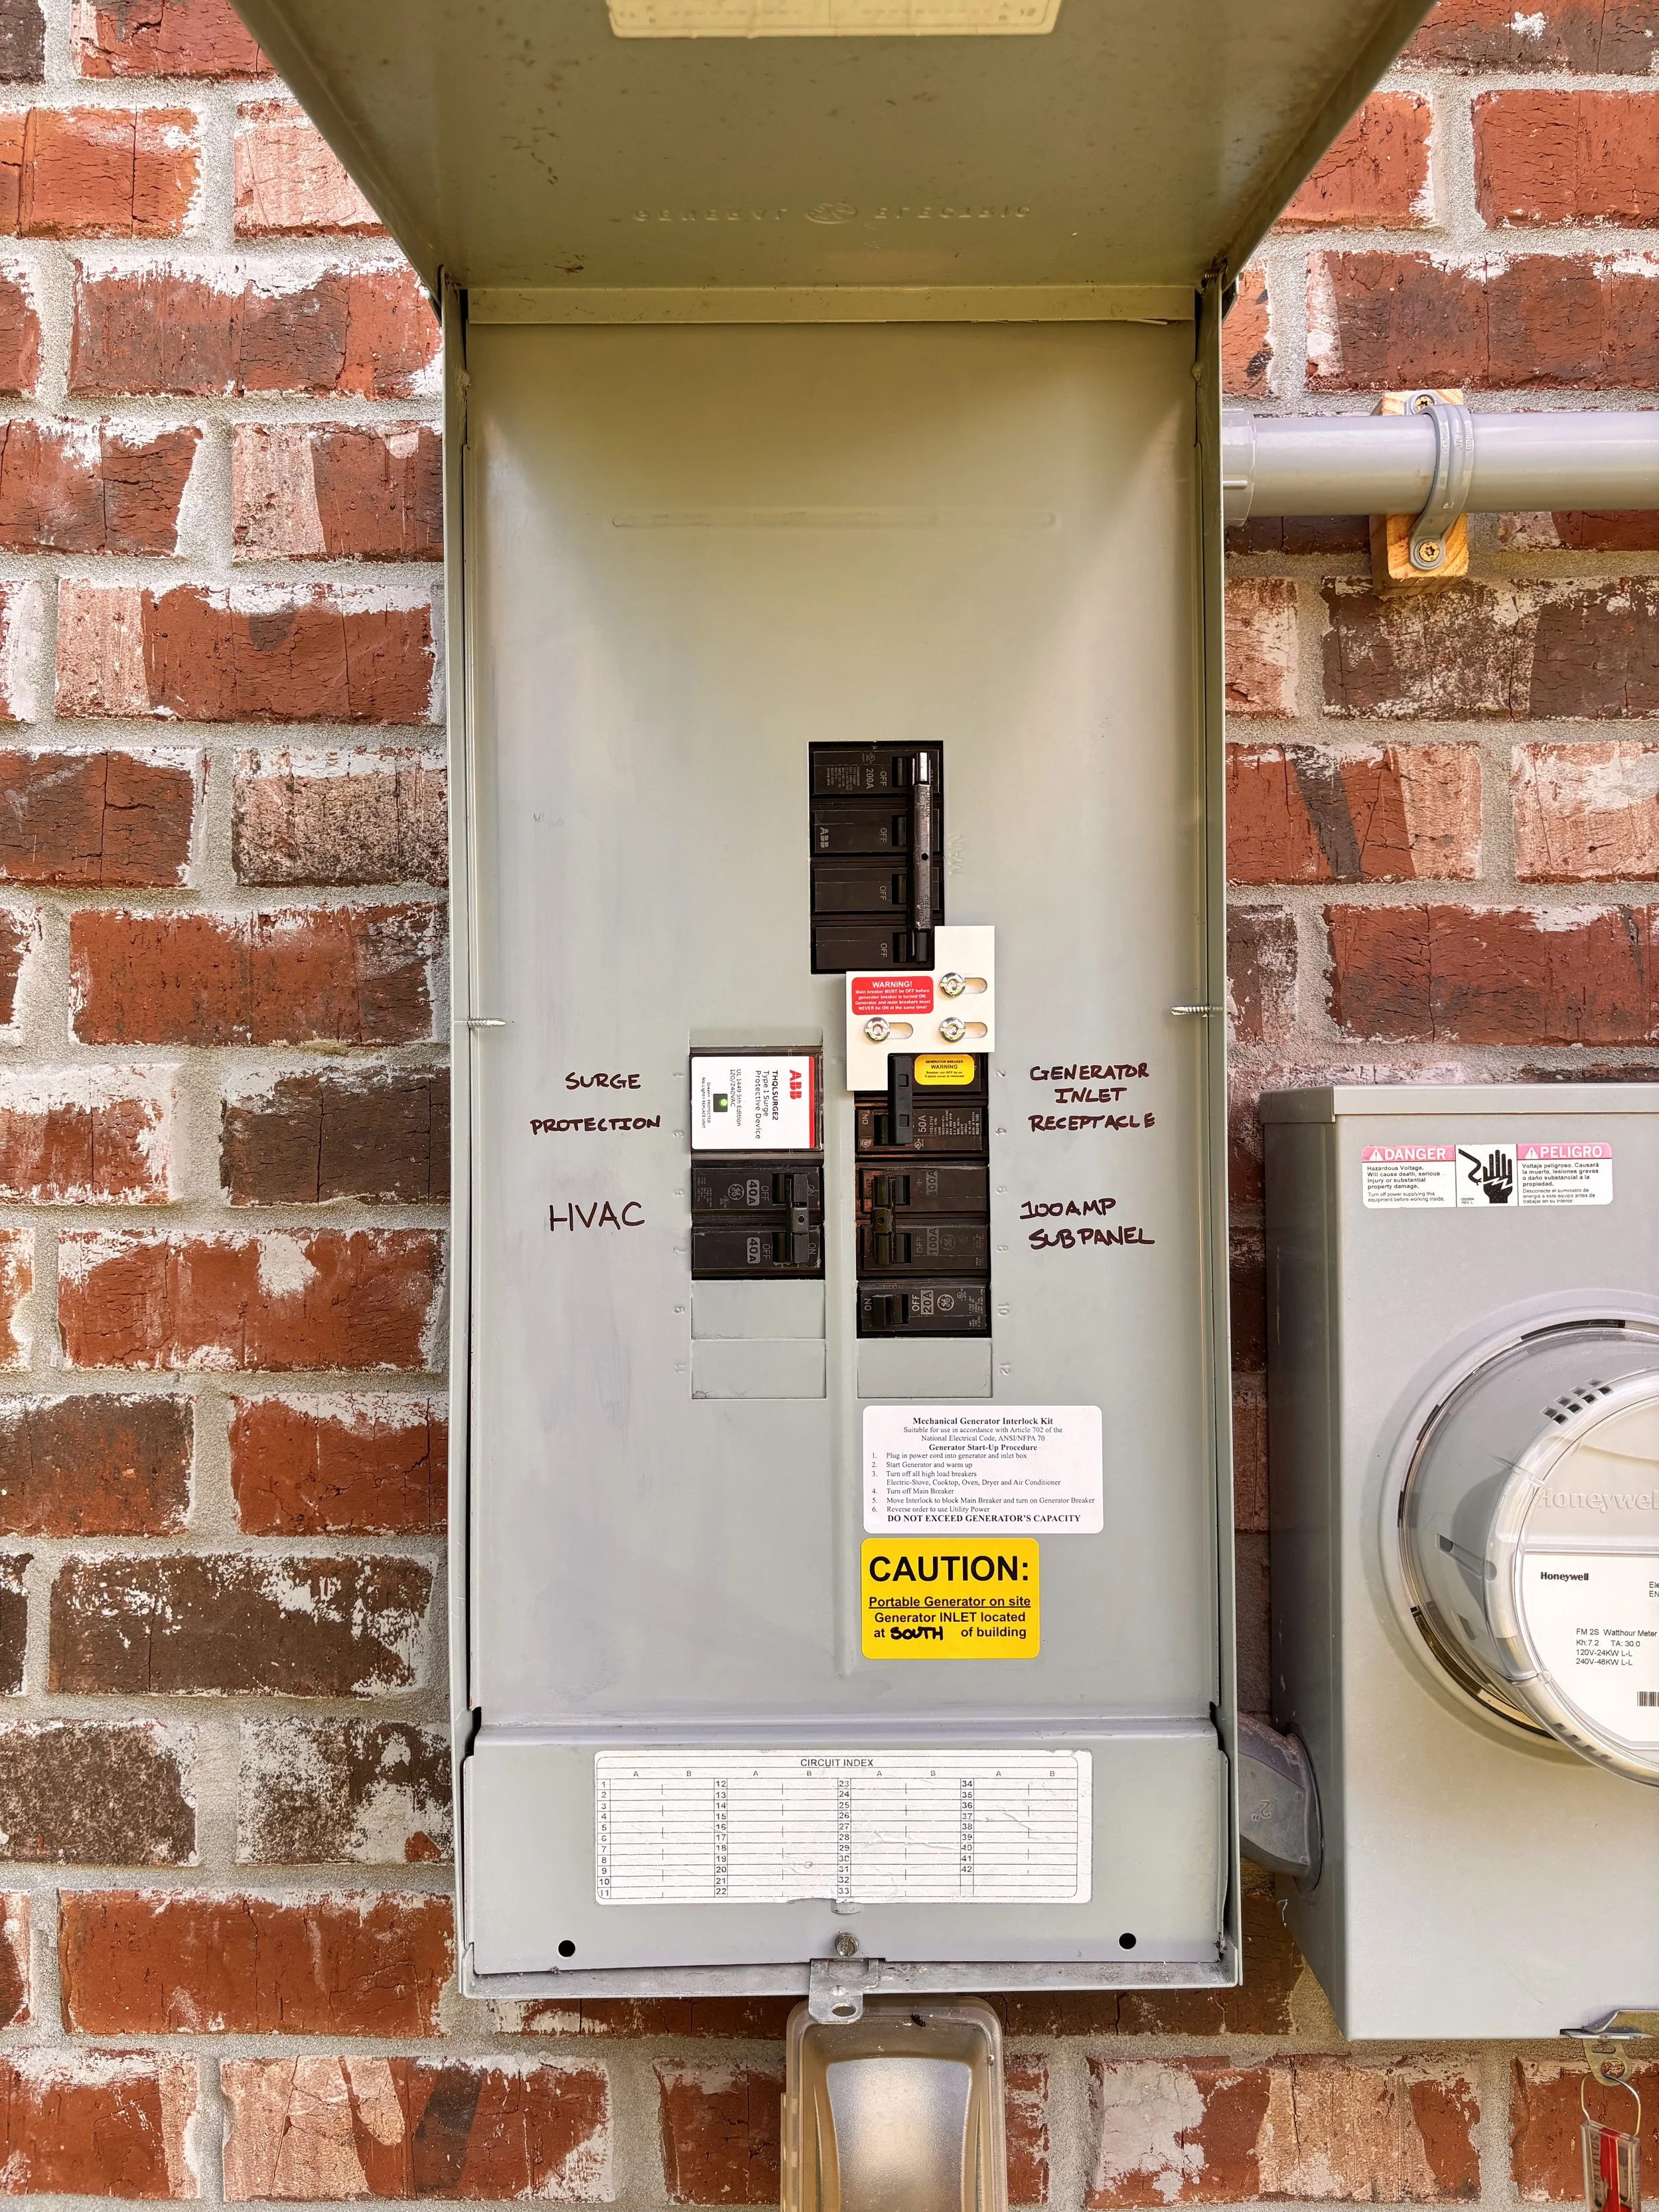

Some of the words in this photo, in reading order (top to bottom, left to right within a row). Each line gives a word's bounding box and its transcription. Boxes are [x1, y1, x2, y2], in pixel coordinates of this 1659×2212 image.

[865, 768, 875, 790] 200A
[820, 826, 830, 848] ABB
[736, 1069, 741, 1077] UL
[1030, 1063, 1149, 1080] GENERATOR
[565, 1072, 640, 1090] SURGE
[790, 1070, 802, 1099] ABB
[1054, 1087, 1127, 1103] INLET
[530, 1115, 660, 1135] PROTECTION
[862, 1114, 869, 1126] ON
[1028, 1112, 1155, 1132] RECEPTACLE
[1384, 1147, 1447, 1160] DANGER
[1540, 1145, 1603, 1158] PELIGRO
[748, 1181, 758, 1205] 40A
[549, 1201, 644, 1231] HVAC
[809, 1242, 817, 1256] ON
[928, 1229, 938, 1254] 100A
[749, 1238, 759, 1264] 40A
[864, 1299, 872, 1311] ON
[922, 1291, 932, 1314] 20A
[870, 1556, 1028, 1582] CAUTION:
[1541, 1572, 1589, 1582] Honeywell
[868, 1596, 920, 1607] Portable
[924, 1596, 987, 1607] Generator
[989, 1597, 1005, 1607] on
[1009, 1595, 1031, 1607] site
[875, 1613, 936, 1622] Generator
[940, 1612, 977, 1622] INLET
[981, 1612, 1025, 1622] located
[874, 1629, 885, 1637] at
[891, 1626, 943, 1641] SOUTH
[961, 1627, 973, 1637] of
[977, 1627, 1026, 1639] building
